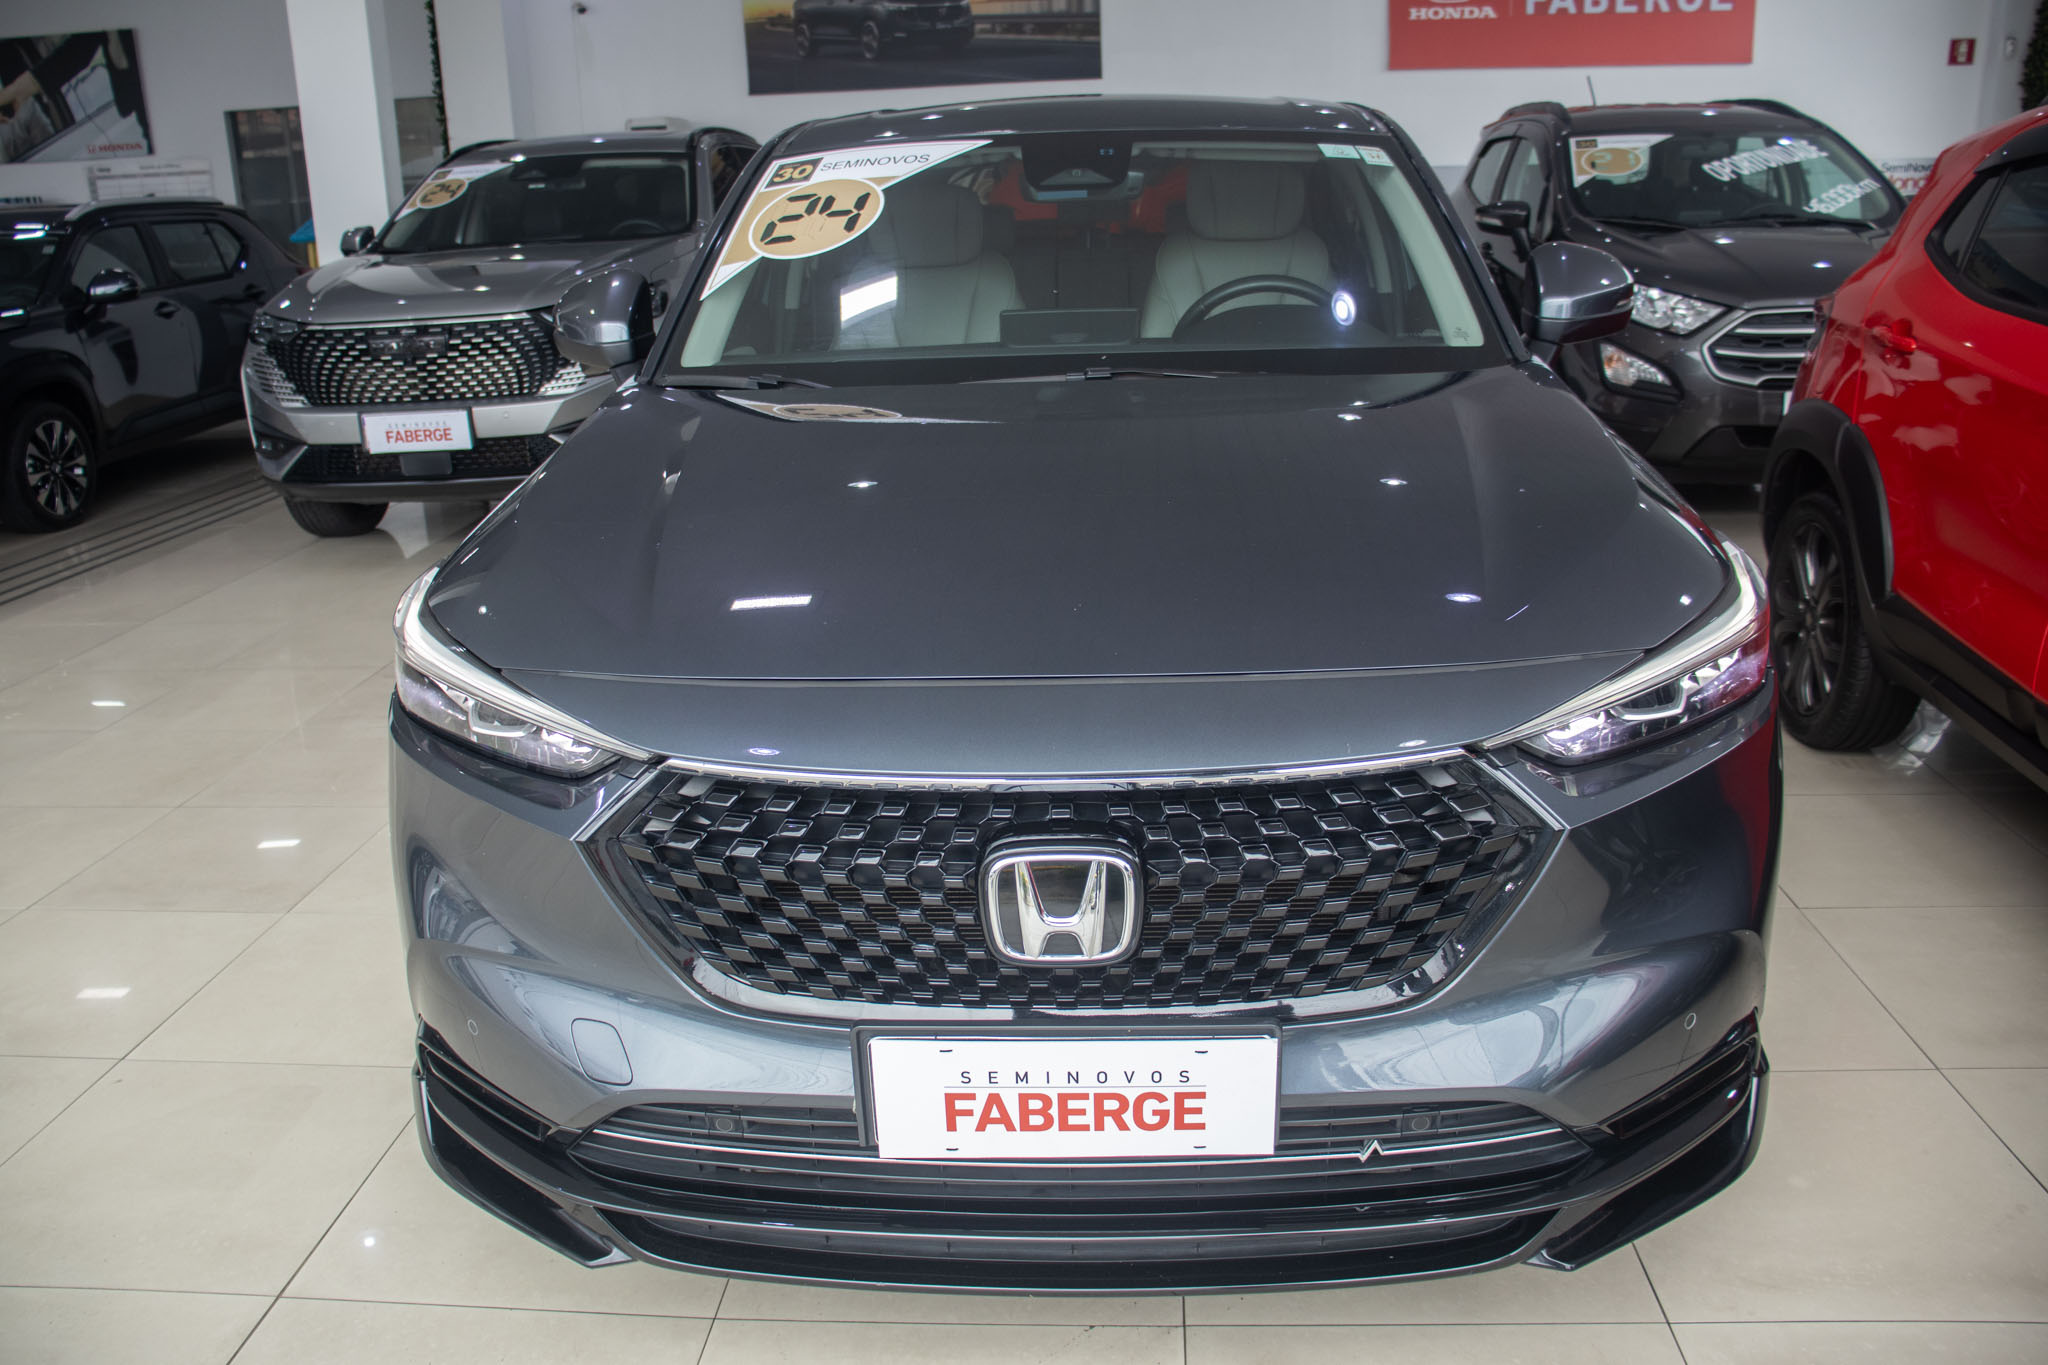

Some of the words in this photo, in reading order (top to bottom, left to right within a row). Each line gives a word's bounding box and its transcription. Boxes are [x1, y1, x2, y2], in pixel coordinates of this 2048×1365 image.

[1408, 7, 1498, 21] HONDA
[820, 154, 931, 172] SEMINOVOS
[773, 164, 814, 183] 30
[759, 191, 872, 246] 24
[385, 427, 453, 444] FABERGE
[960, 1070, 1191, 1085] SEMINOVOS
[943, 1091, 1208, 1133] FABERGE
